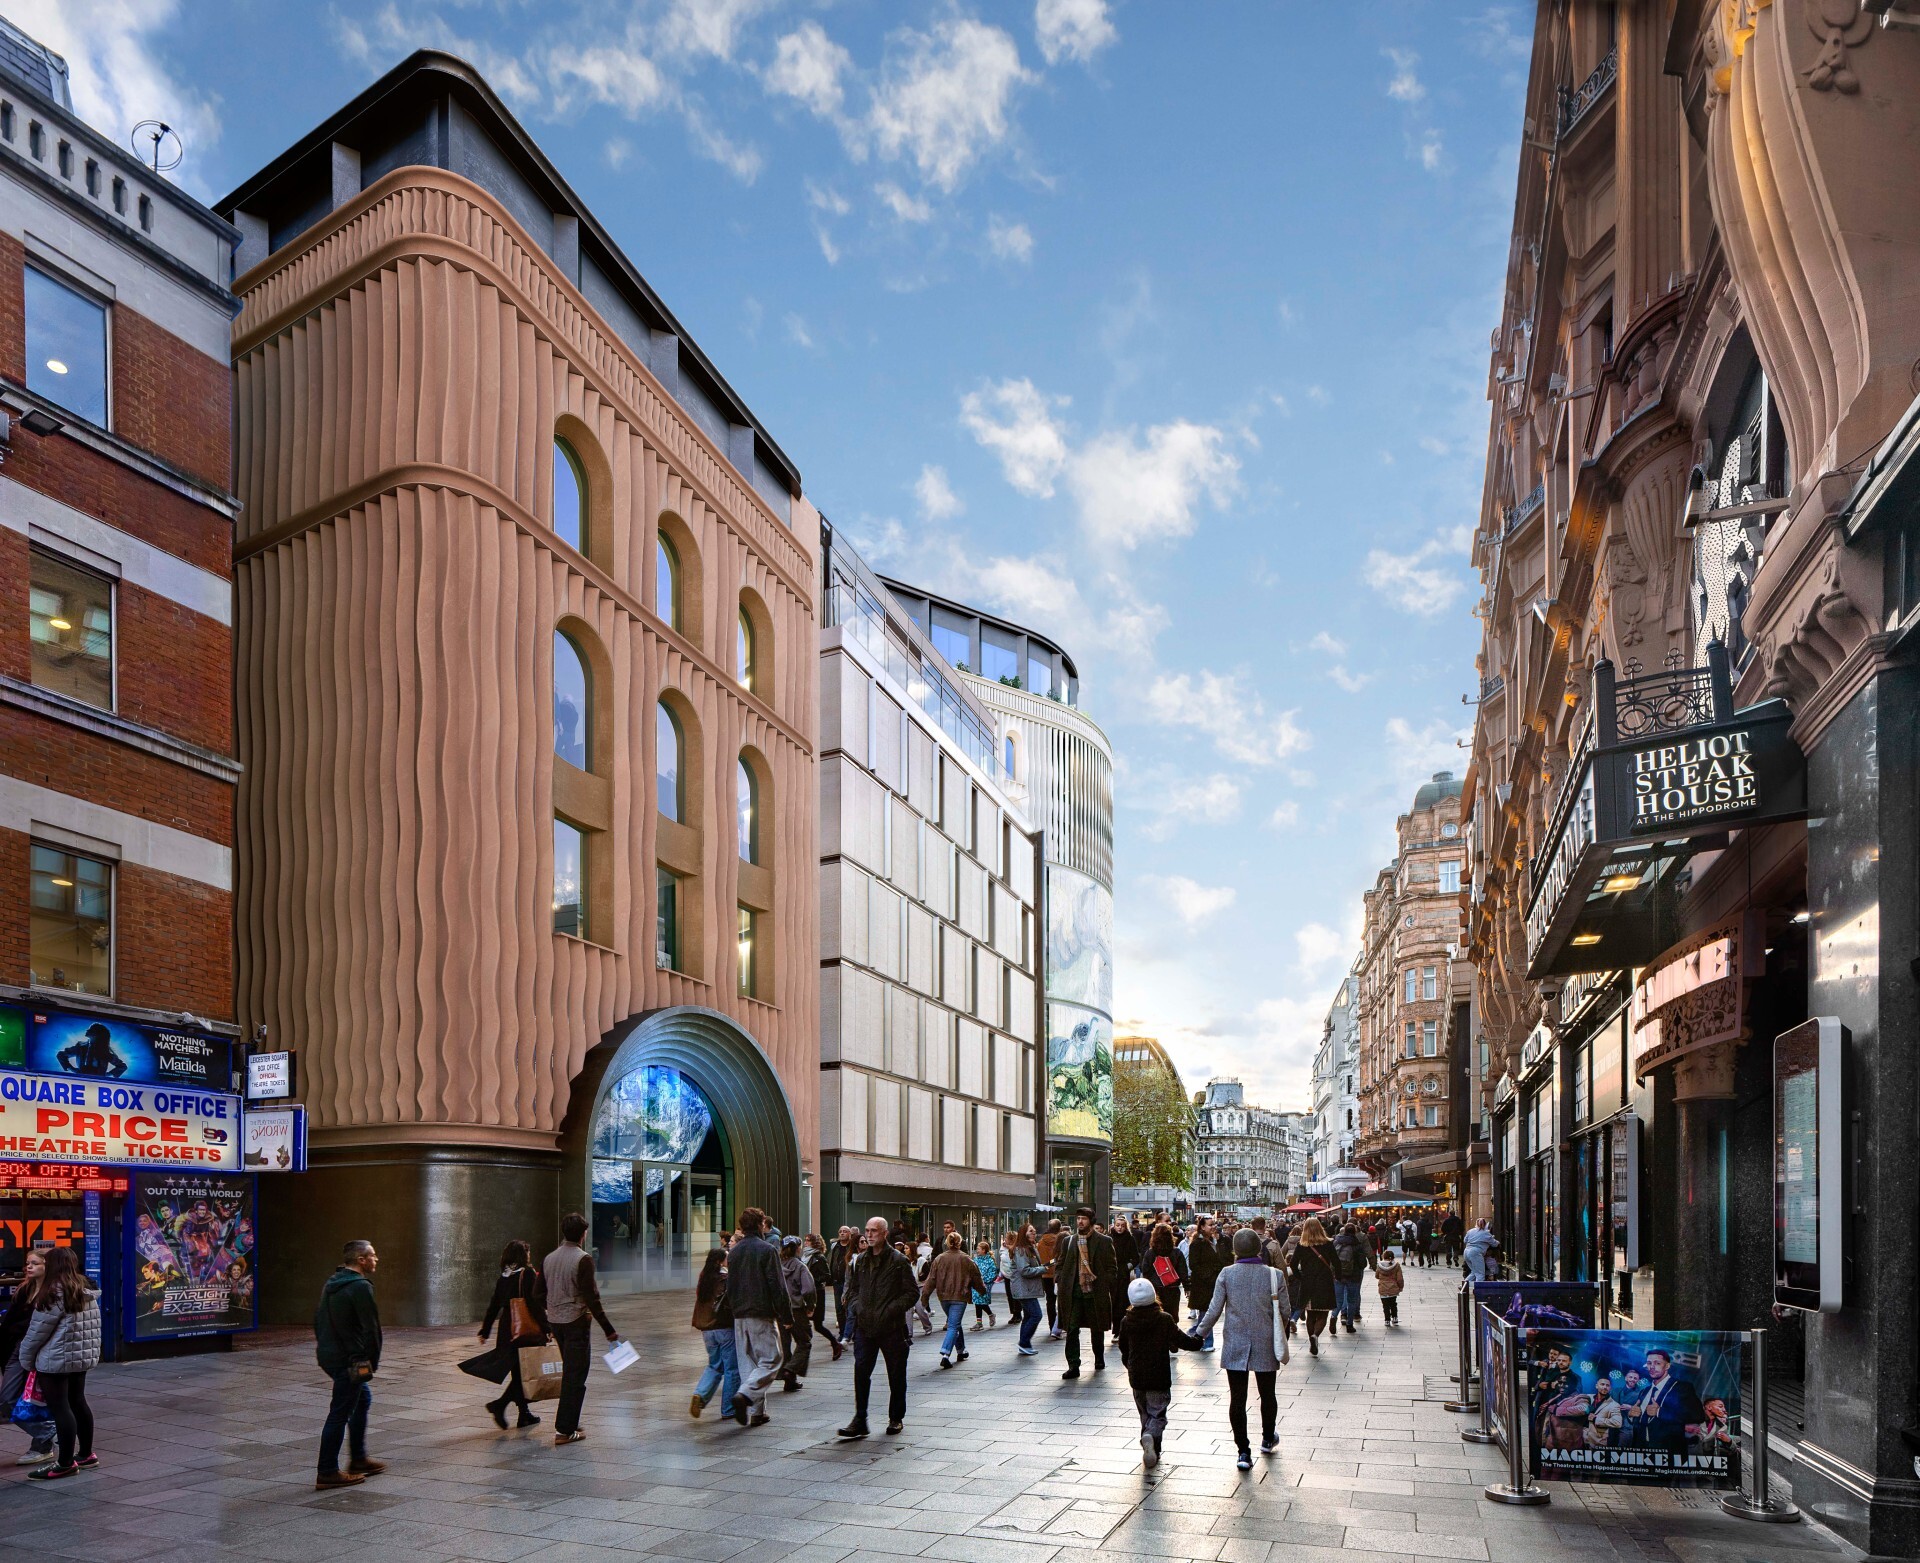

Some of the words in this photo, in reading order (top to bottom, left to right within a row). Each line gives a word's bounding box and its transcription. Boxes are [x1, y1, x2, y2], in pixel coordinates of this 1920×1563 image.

[1634, 732, 1749, 774] HELIOT
[1636, 753, 1754, 794] STEAK
[1636, 775, 1756, 816] HOUSE
[1636, 816, 1648, 825] AT
[1654, 812, 1674, 822] THE
[1680, 798, 1756, 818] HIPPODROME
[154, 1040, 200, 1054] MATCHES
[160, 1056, 206, 1074] Matilda
[1, 1077, 85, 1105] QUARE
[98, 1086, 144, 1111] BOX
[154, 1092, 227, 1119] OFFICE
[37, 1108, 188, 1142] PRICE
[124, 1143, 221, 1162] TICKETS
[0, 1163, 30, 1175] BOX
[40, 1165, 99, 1177] OFFICE
[0, 1220, 84, 1248] YE-
[164, 1291, 230, 1301] STARLIGHT
[163, 1301, 229, 1314] EXPRESS
[1540, 1448, 1605, 1463] MAGIC
[1610, 1452, 1668, 1466] MIKE
[1673, 1454, 1728, 1469] LIVE
[1655, 1468, 1728, 1477] MagicMikeLondon.co.uk
